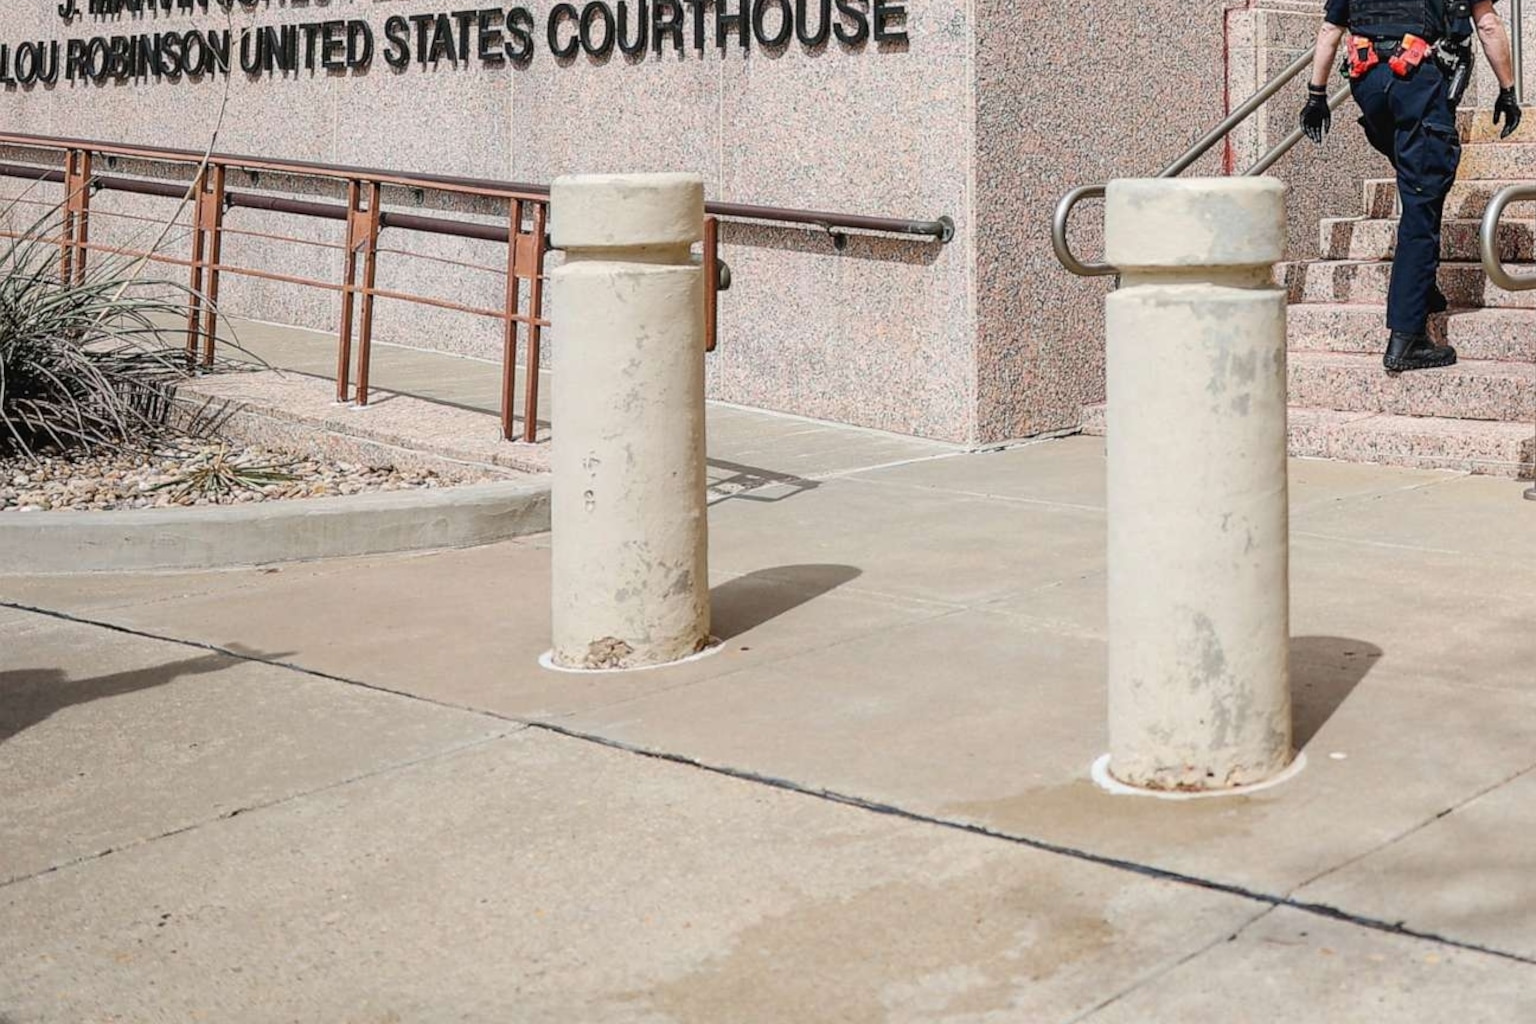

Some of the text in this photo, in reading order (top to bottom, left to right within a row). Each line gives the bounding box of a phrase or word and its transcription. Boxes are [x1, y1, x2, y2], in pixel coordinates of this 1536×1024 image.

[66, 29, 230, 79] ROBINSON
[240, 19, 373, 73] UNITED
[384, 7, 534, 68] STATES
